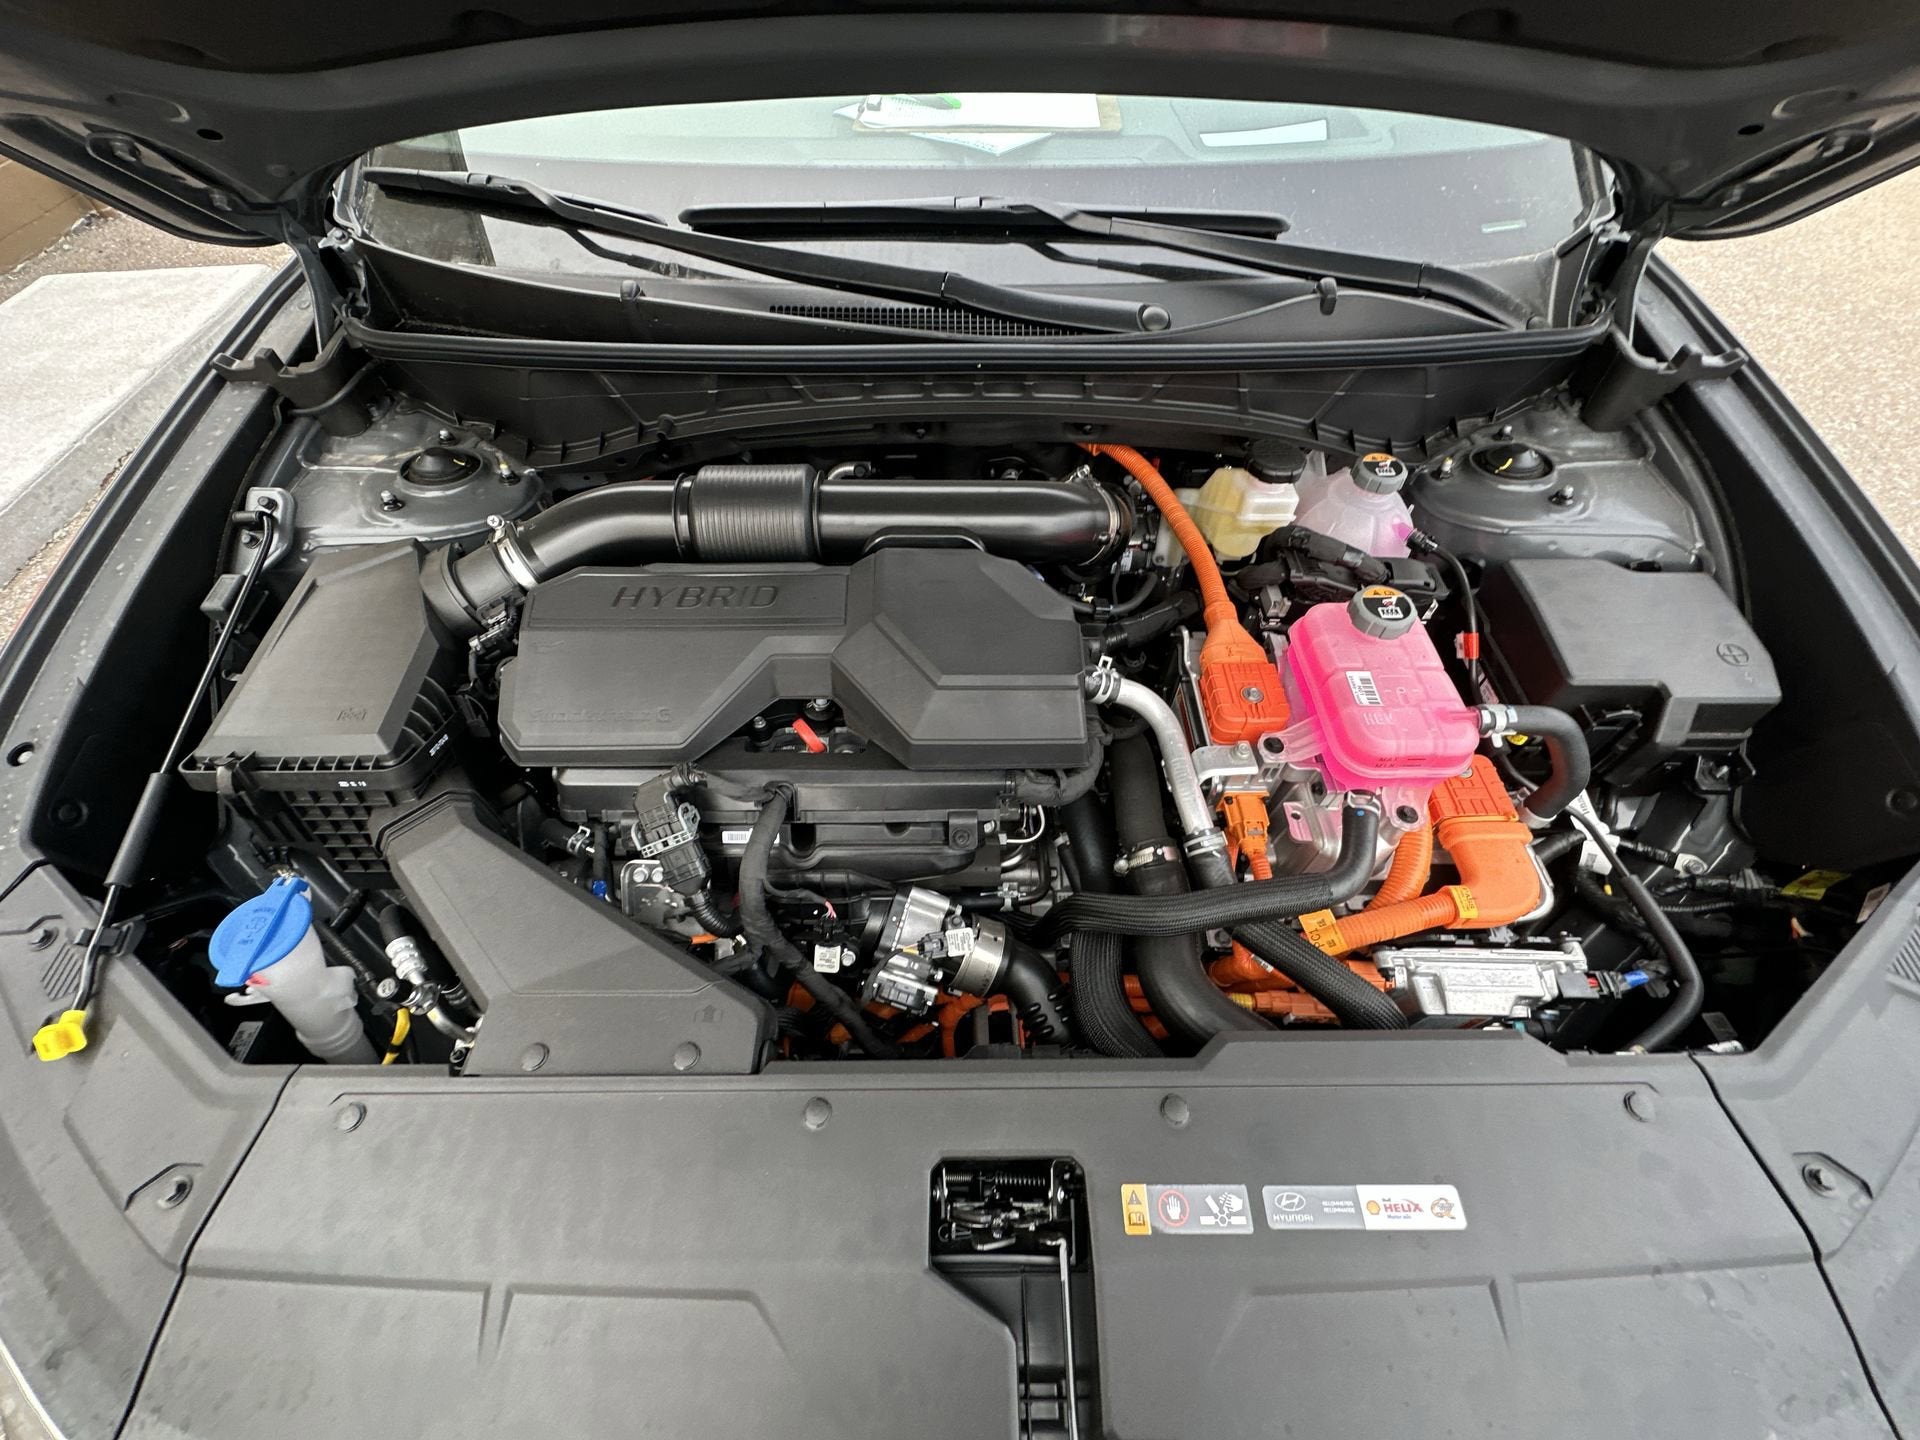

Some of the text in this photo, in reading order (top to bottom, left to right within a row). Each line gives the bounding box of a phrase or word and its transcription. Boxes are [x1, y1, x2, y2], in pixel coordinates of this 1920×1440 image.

[610, 585, 779, 610] HYBRID
[1383, 1202, 1424, 1213] HELIX
[1272, 1212, 1314, 1223] HYUNDAI
